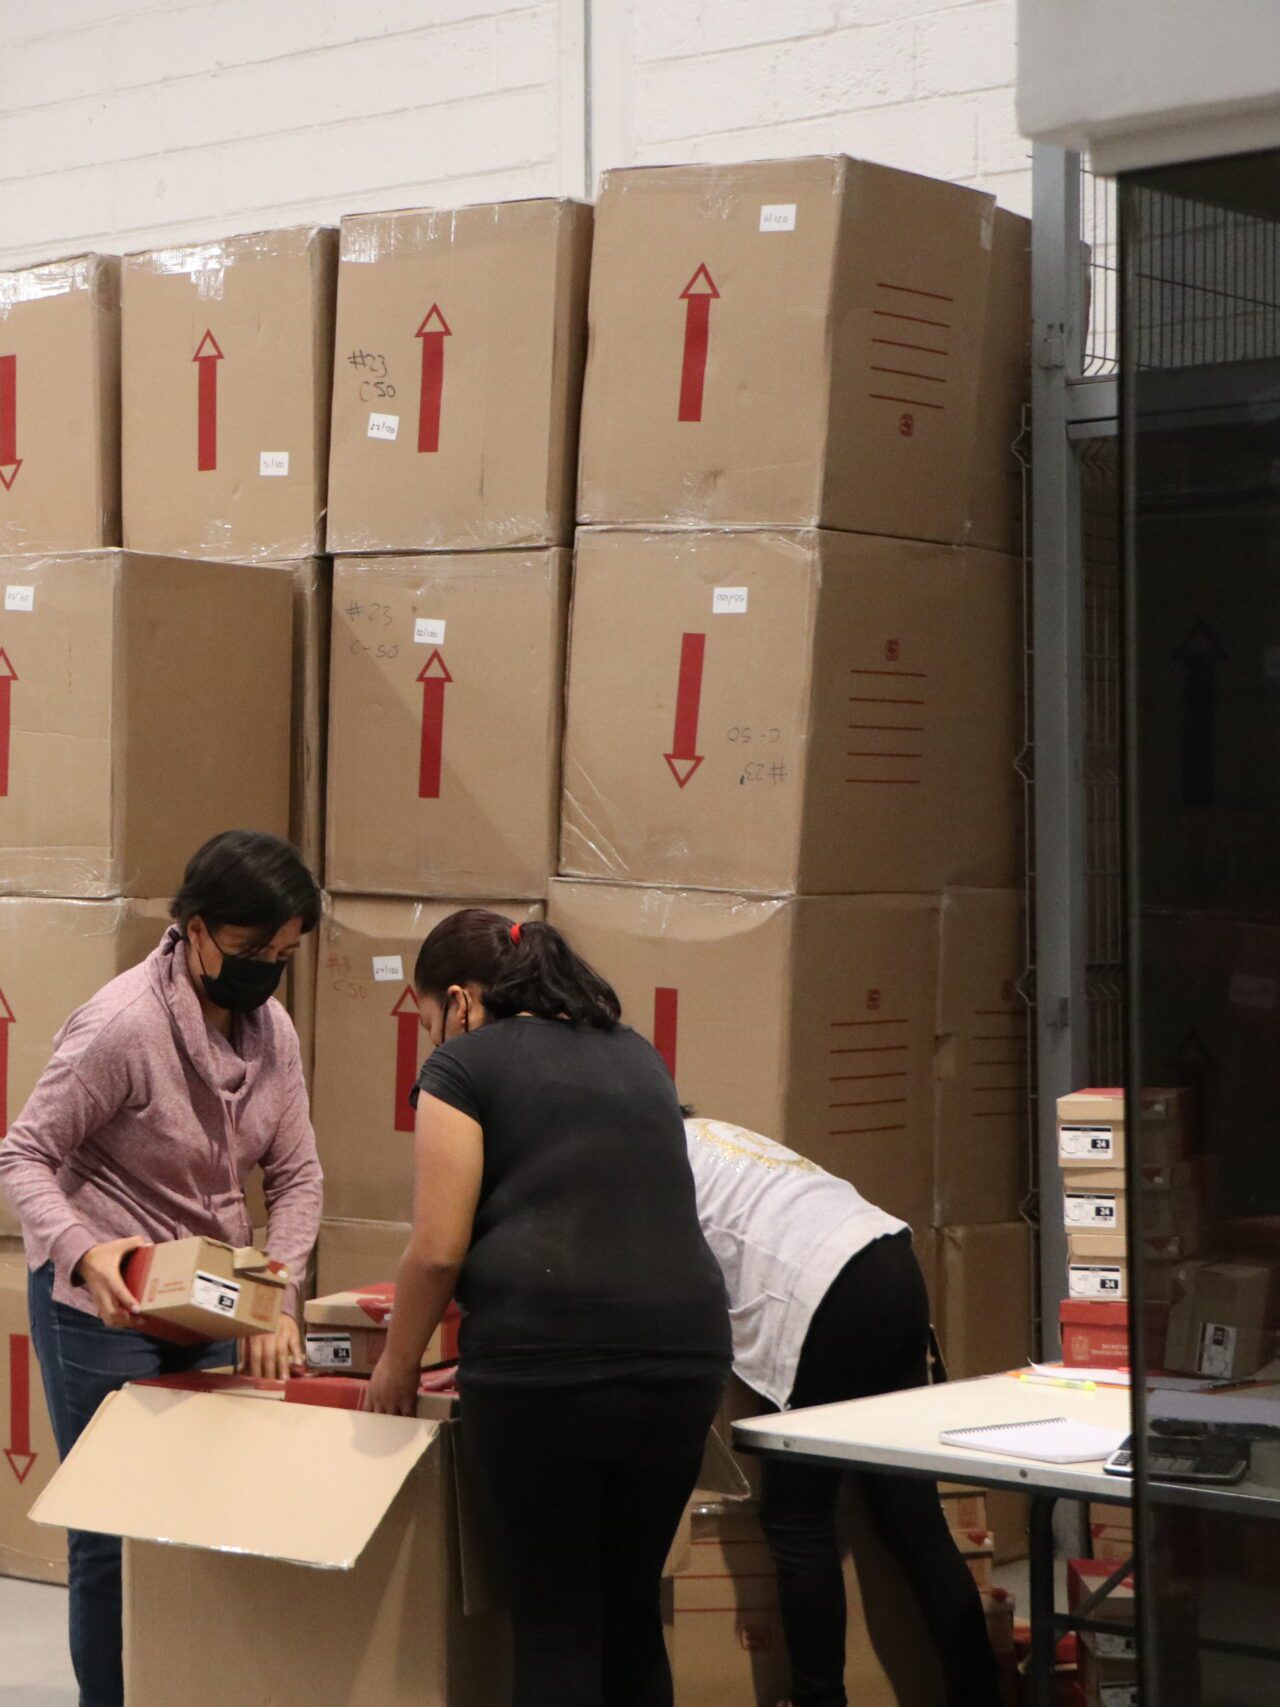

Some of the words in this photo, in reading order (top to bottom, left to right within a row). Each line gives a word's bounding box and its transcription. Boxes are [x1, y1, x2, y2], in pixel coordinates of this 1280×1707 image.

[347, 348, 388, 378] #23
[1095, 1140, 1107, 1148] 24
[1100, 1207, 1111, 1216] 24
[1104, 1280, 1116, 1288] 24
